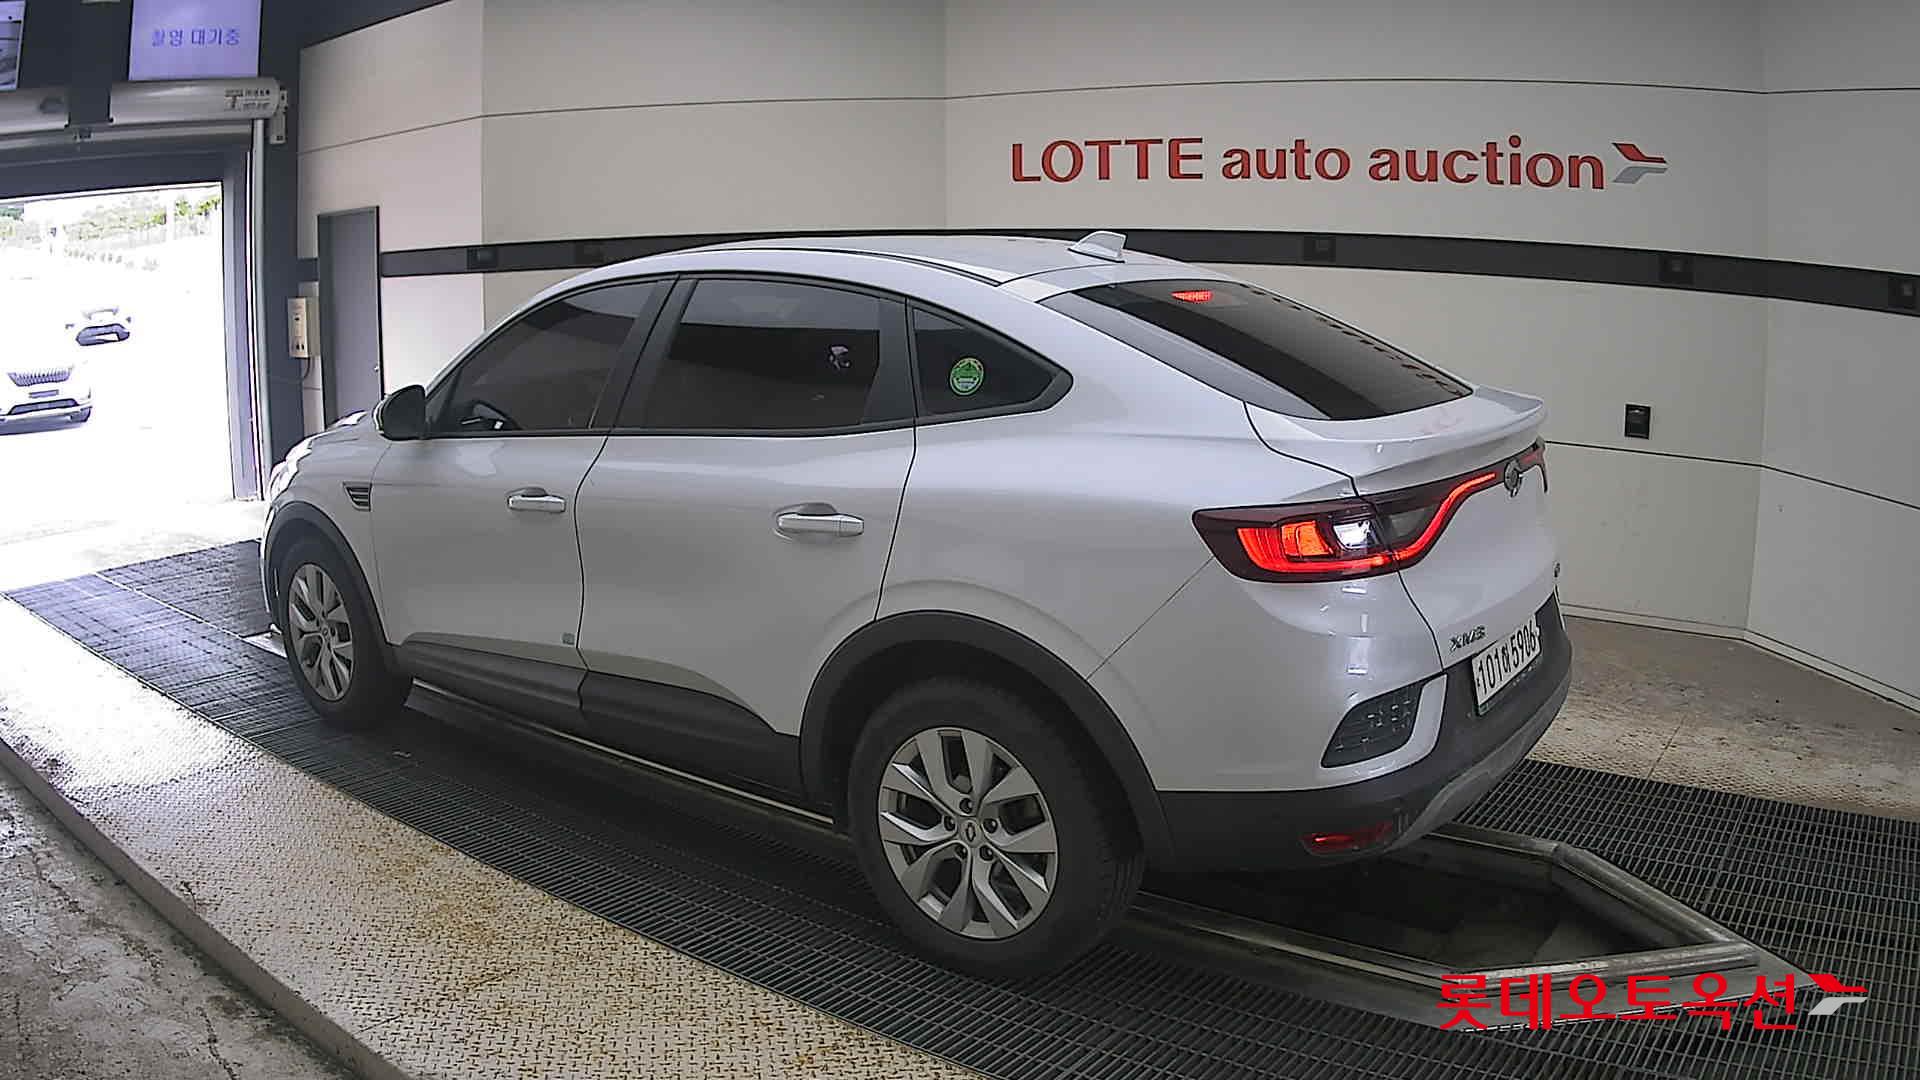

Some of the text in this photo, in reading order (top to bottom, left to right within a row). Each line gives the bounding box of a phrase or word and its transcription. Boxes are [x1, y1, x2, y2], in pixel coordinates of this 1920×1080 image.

[1011, 135, 1606, 190] LOTTE auto auction
